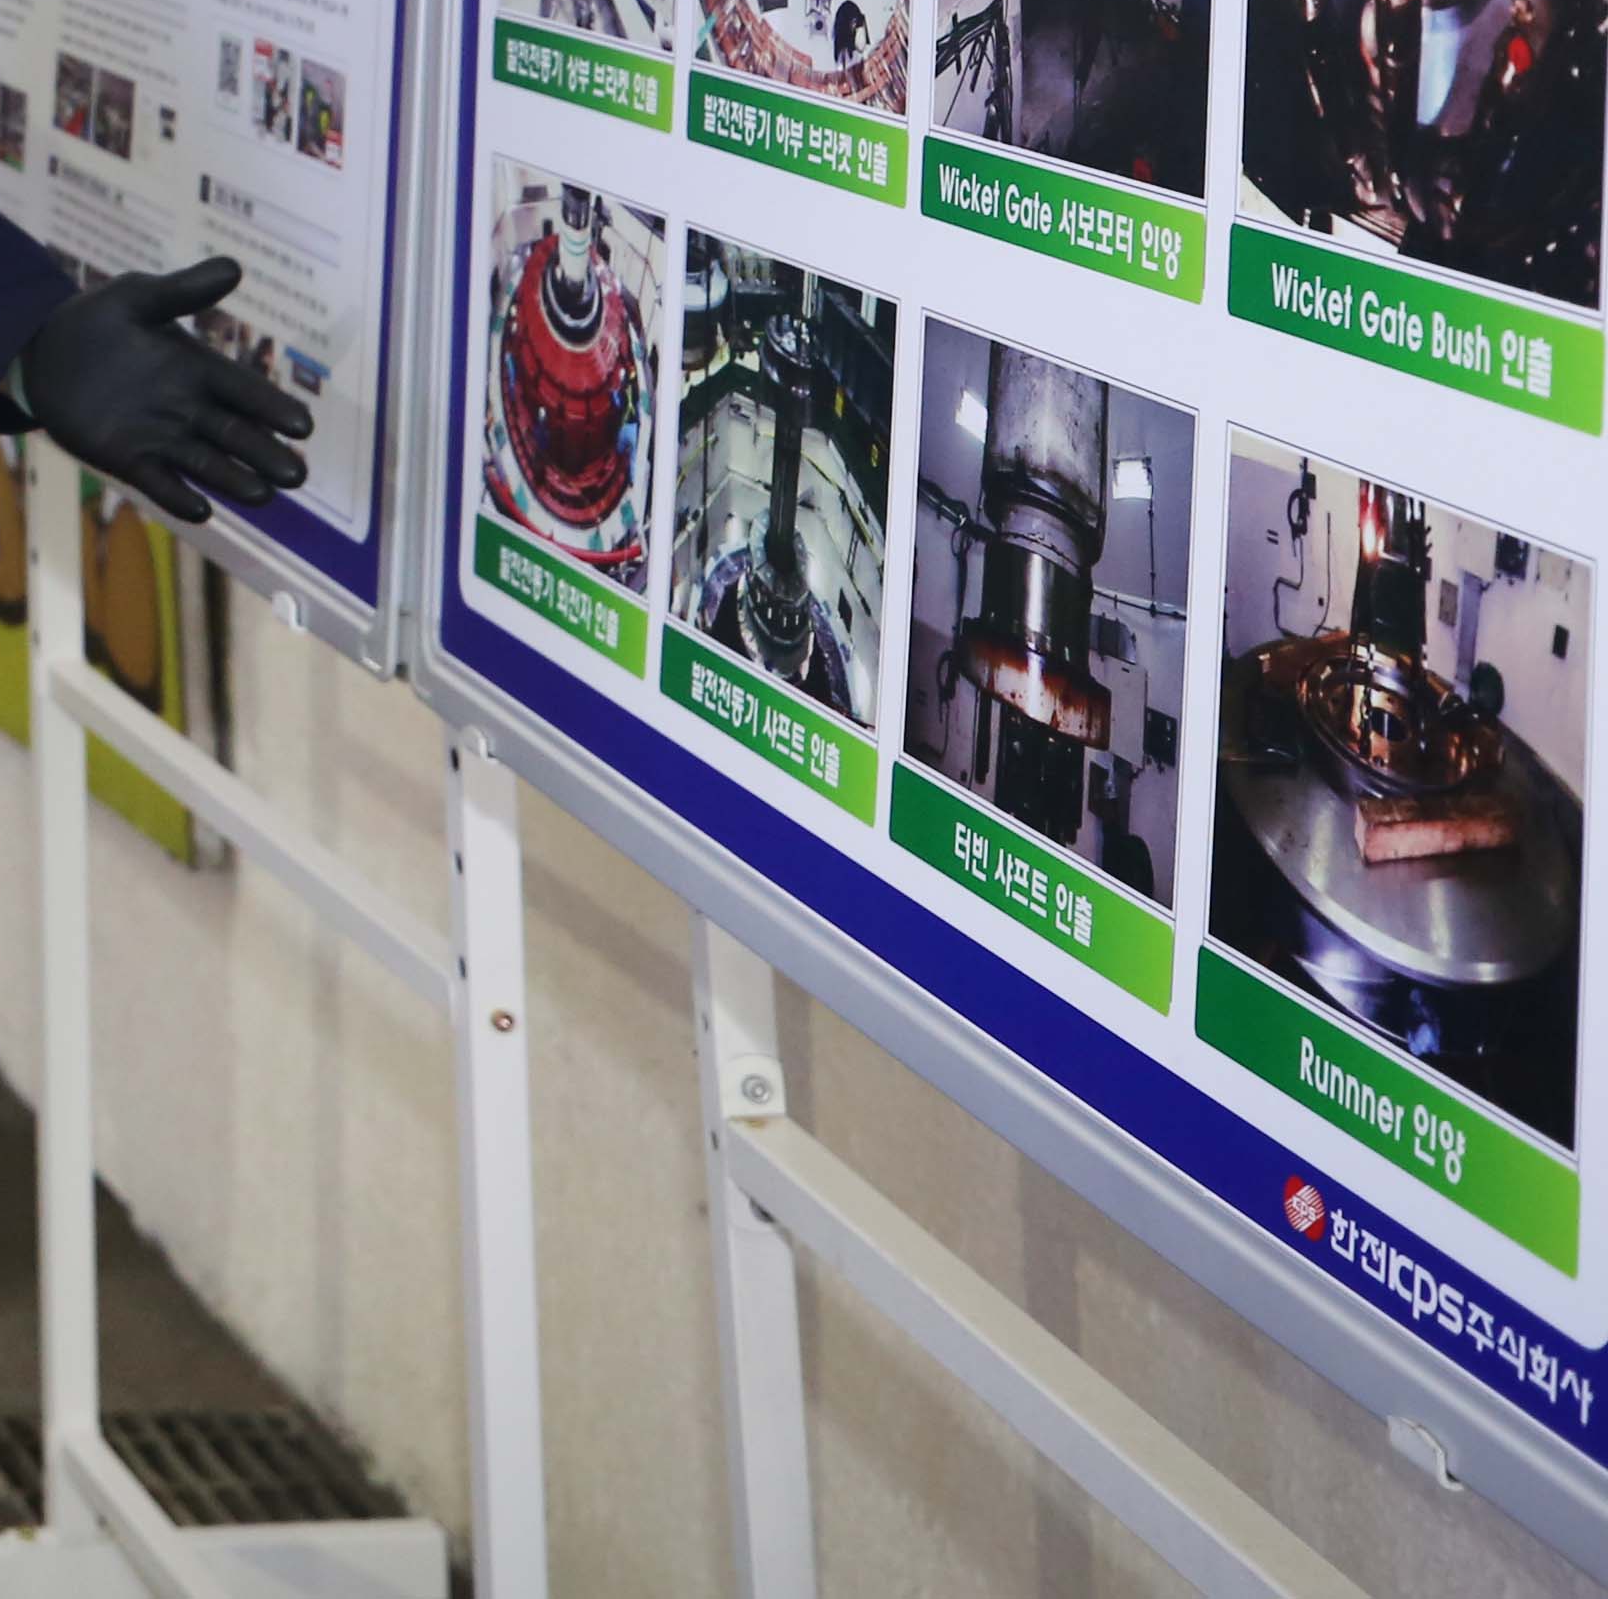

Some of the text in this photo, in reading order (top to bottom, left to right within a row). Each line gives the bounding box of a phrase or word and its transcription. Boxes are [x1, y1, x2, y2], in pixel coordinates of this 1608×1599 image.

[507, 38, 563, 88] 발전전동기
[592, 62, 630, 106] 브라켓
[633, 72, 659, 116] 인출
[704, 93, 889, 187] 발전전동기 하부 브라켓 인출
[938, 162, 1182, 281] Wicket Gate 서보모터 인양
[1271, 262, 1553, 399] Wicket Gate Bush 인출
[691, 661, 841, 789] 발전전동기 샤프트 인출
[954, 820, 1094, 948] 터빈 샤프트 인출
[1299, 1035, 1466, 1186] Runnner 인양
